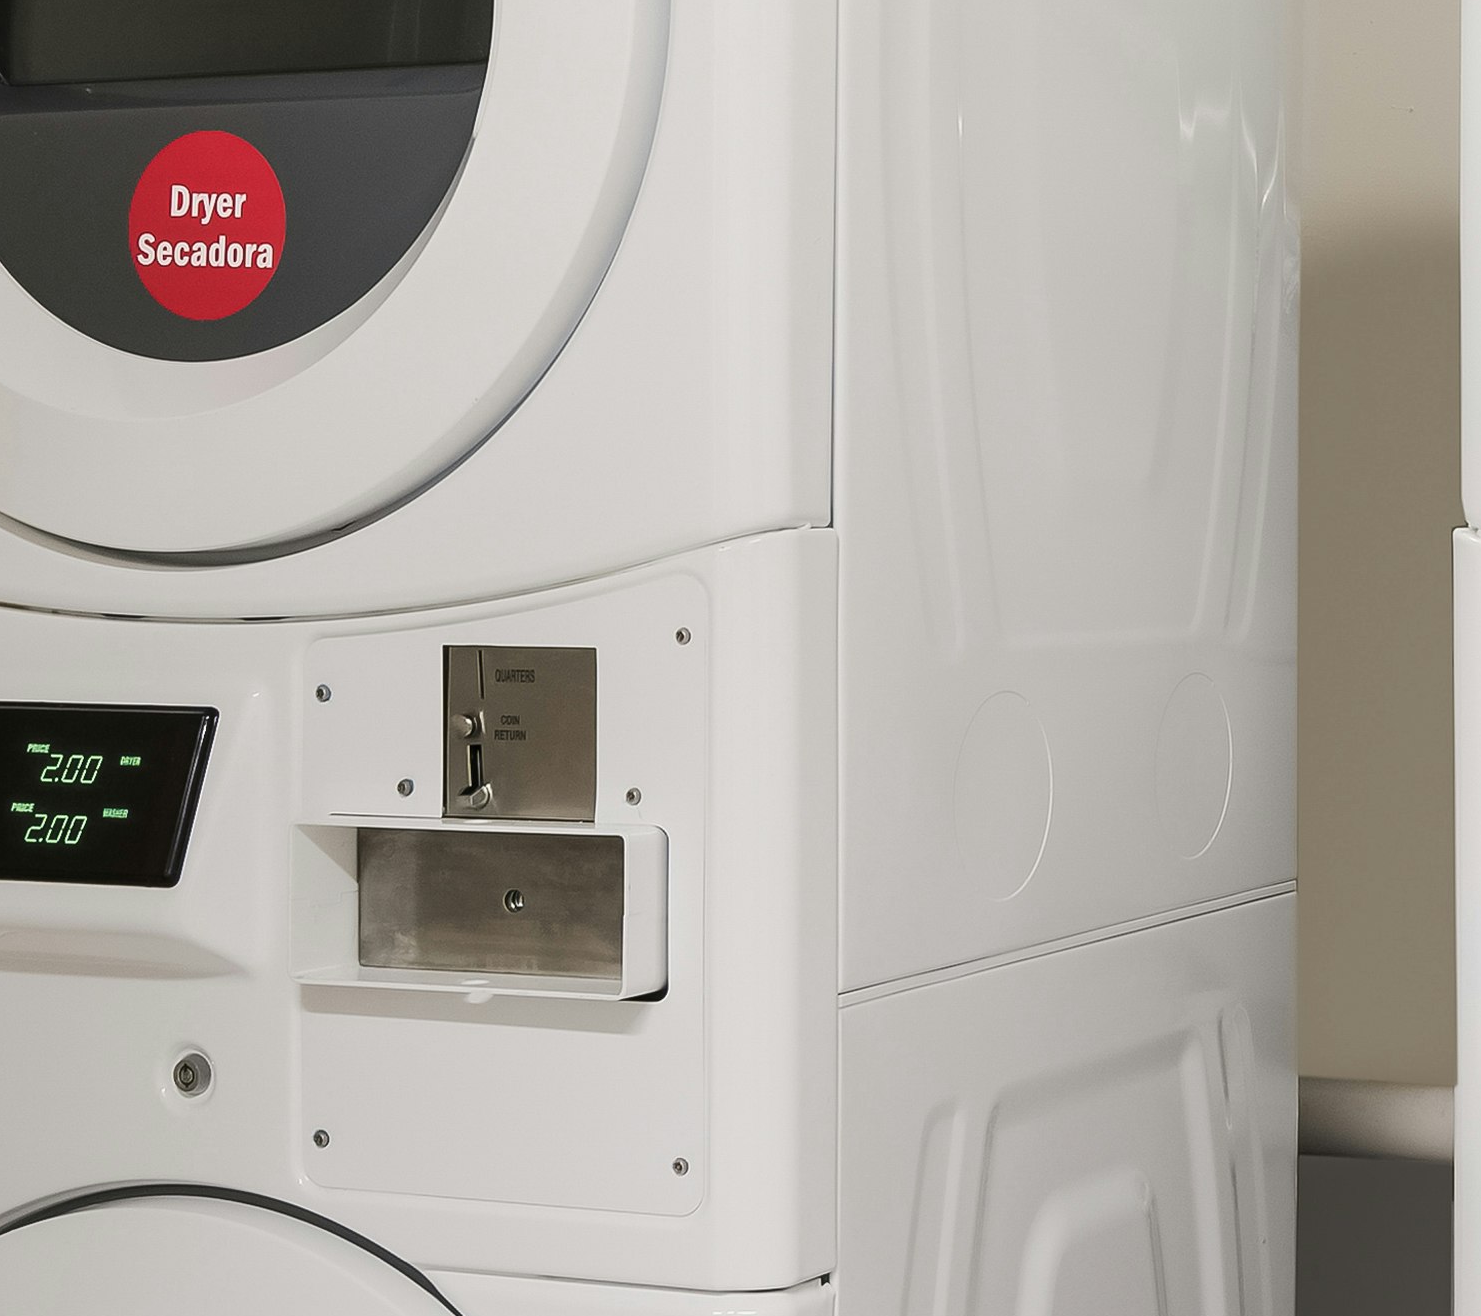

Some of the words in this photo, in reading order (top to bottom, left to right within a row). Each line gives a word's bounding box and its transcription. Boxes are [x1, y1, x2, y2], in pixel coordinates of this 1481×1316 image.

[170, 184, 247, 225] Dryer
[136, 233, 274, 269] Secadora
[495, 669, 536, 683] QUARTERS
[494, 730, 527, 741] RETURN
[500, 715, 520, 725] COIN
[27, 743, 50, 753] PRICE
[40, 754, 103, 784] 2.00
[120, 756, 141, 766] DRYER
[11, 802, 35, 812] PRICE
[24, 814, 87, 844] 2.00
